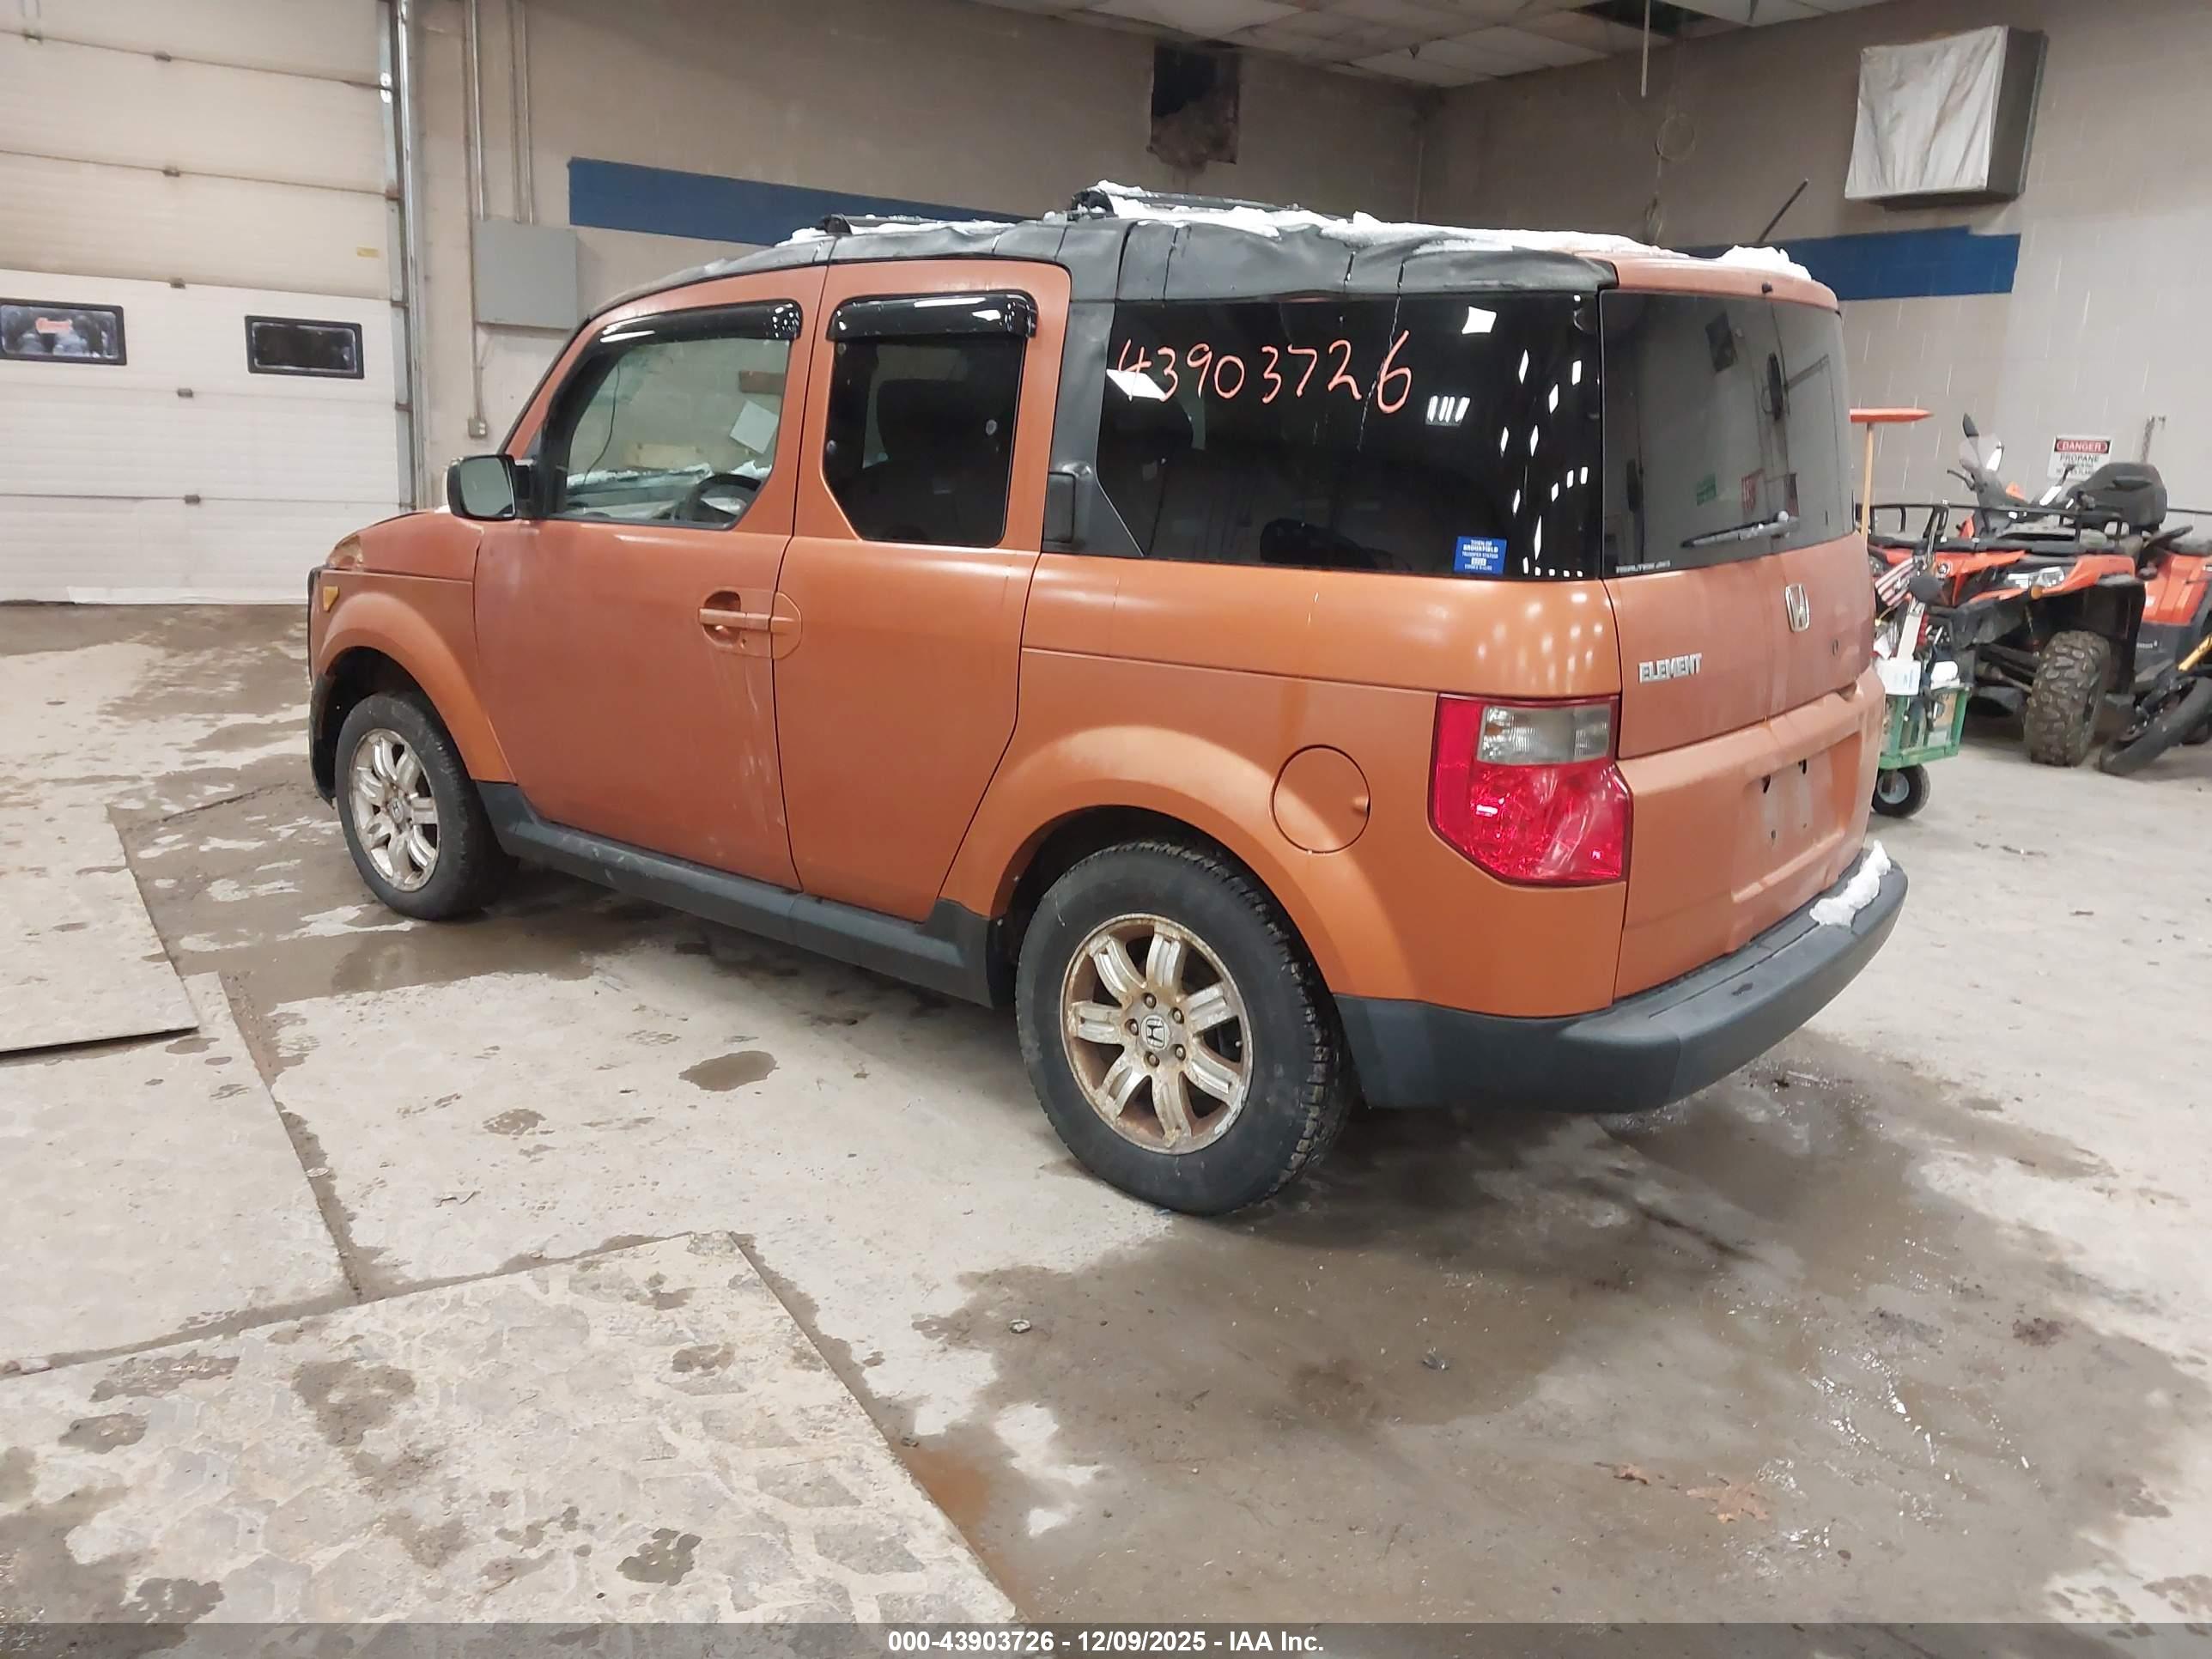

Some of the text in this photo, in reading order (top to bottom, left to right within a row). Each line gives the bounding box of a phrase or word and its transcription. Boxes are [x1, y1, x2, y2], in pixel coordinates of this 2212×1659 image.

[1118, 329, 1413, 414] 43903726
[2062, 441, 2102, 452] DANGER
[2059, 453, 2100, 462] PROPANE
[1638, 653, 1703, 684] ELEMENT
